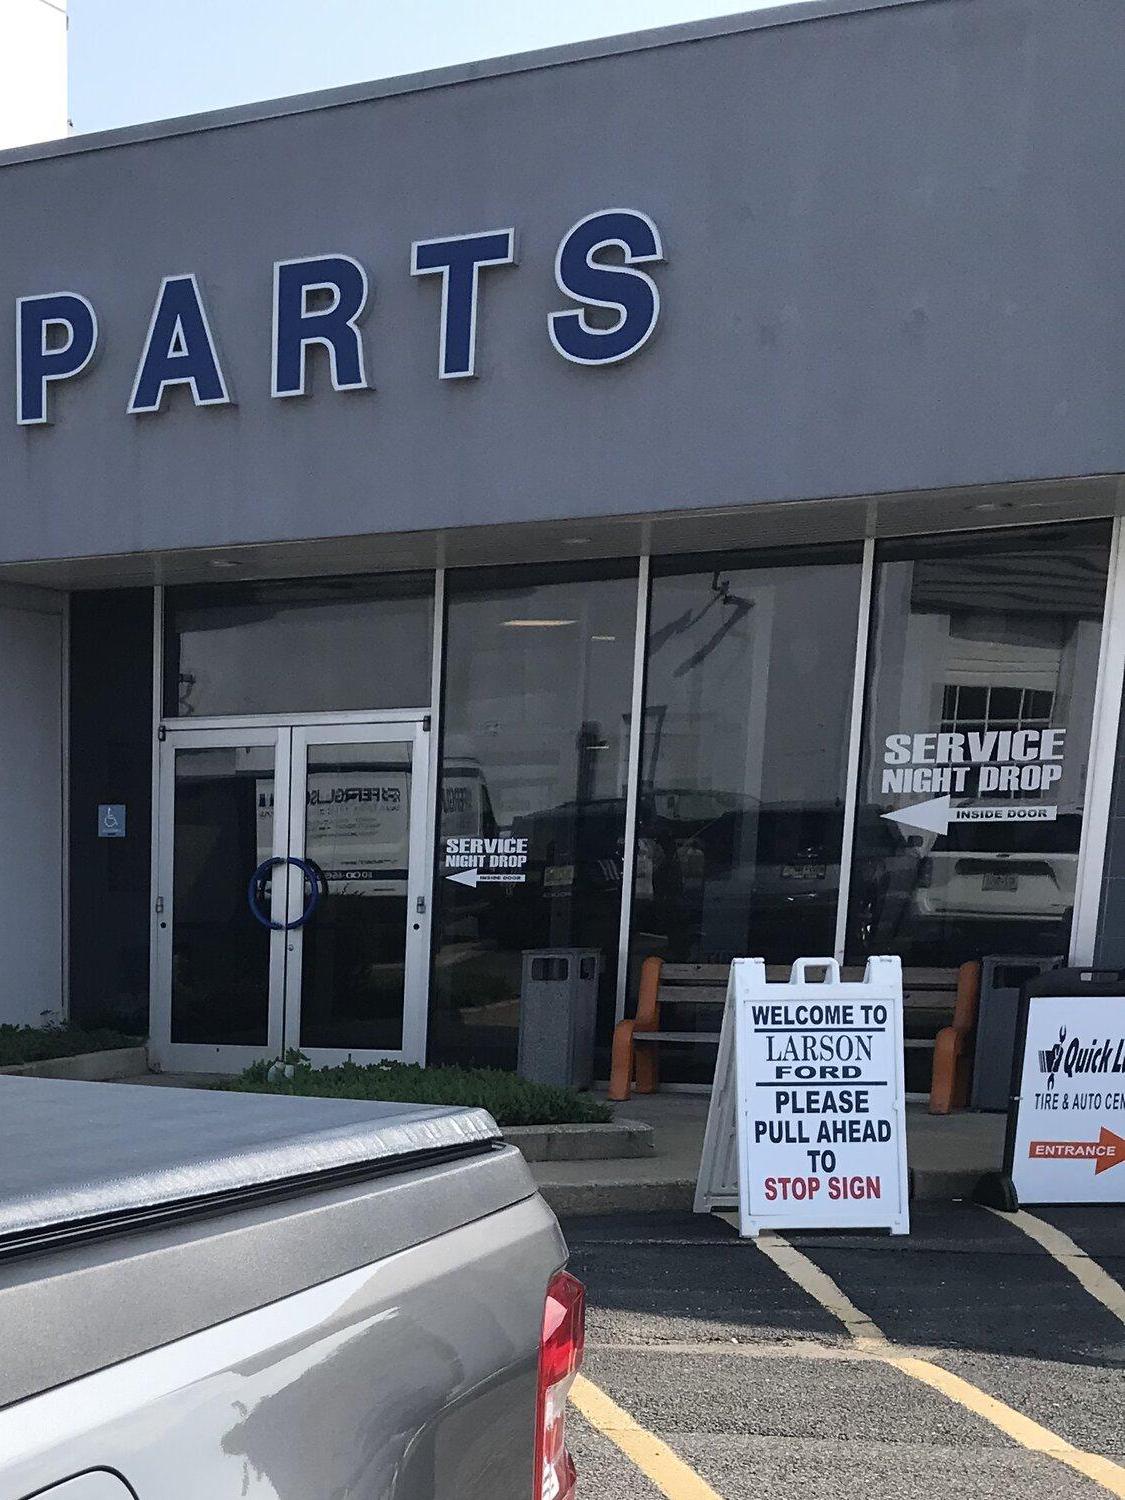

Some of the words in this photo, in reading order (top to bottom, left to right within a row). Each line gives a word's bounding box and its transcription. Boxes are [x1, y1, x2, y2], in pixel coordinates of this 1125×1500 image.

[15, 207, 667, 426] PARTS
[883, 728, 1067, 765] SERVICE
[881, 766, 971, 794] NIGHT
[978, 764, 1063, 792] DROP
[955, 809, 1003, 820] INSIDE
[1007, 808, 1048, 818] DOOR
[445, 837, 529, 855] SERVICE
[444, 854, 487, 868] NIGHT
[489, 854, 528, 868] DROP
[751, 1005, 854, 1026] WELCOME
[860, 1004, 888, 1025] TO
[765, 1034, 874, 1062] LARSON
[1063, 1037, 1114, 1078] Quick
[775, 1065, 863, 1080] FORD
[775, 1090, 869, 1114] PLEASE
[1034, 1093, 1060, 1110] TIRE
[1061, 1092, 1069, 1110] &
[1071, 1093, 1102, 1110] AUTO
[754, 1120, 810, 1144] PULL
[816, 1119, 892, 1143] AHEAD
[806, 1149, 837, 1173] TO
[1035, 1145, 1116, 1156] ENTRANCE
[764, 1177, 821, 1201] STOP
[828, 1176, 881, 1199] SIGN
